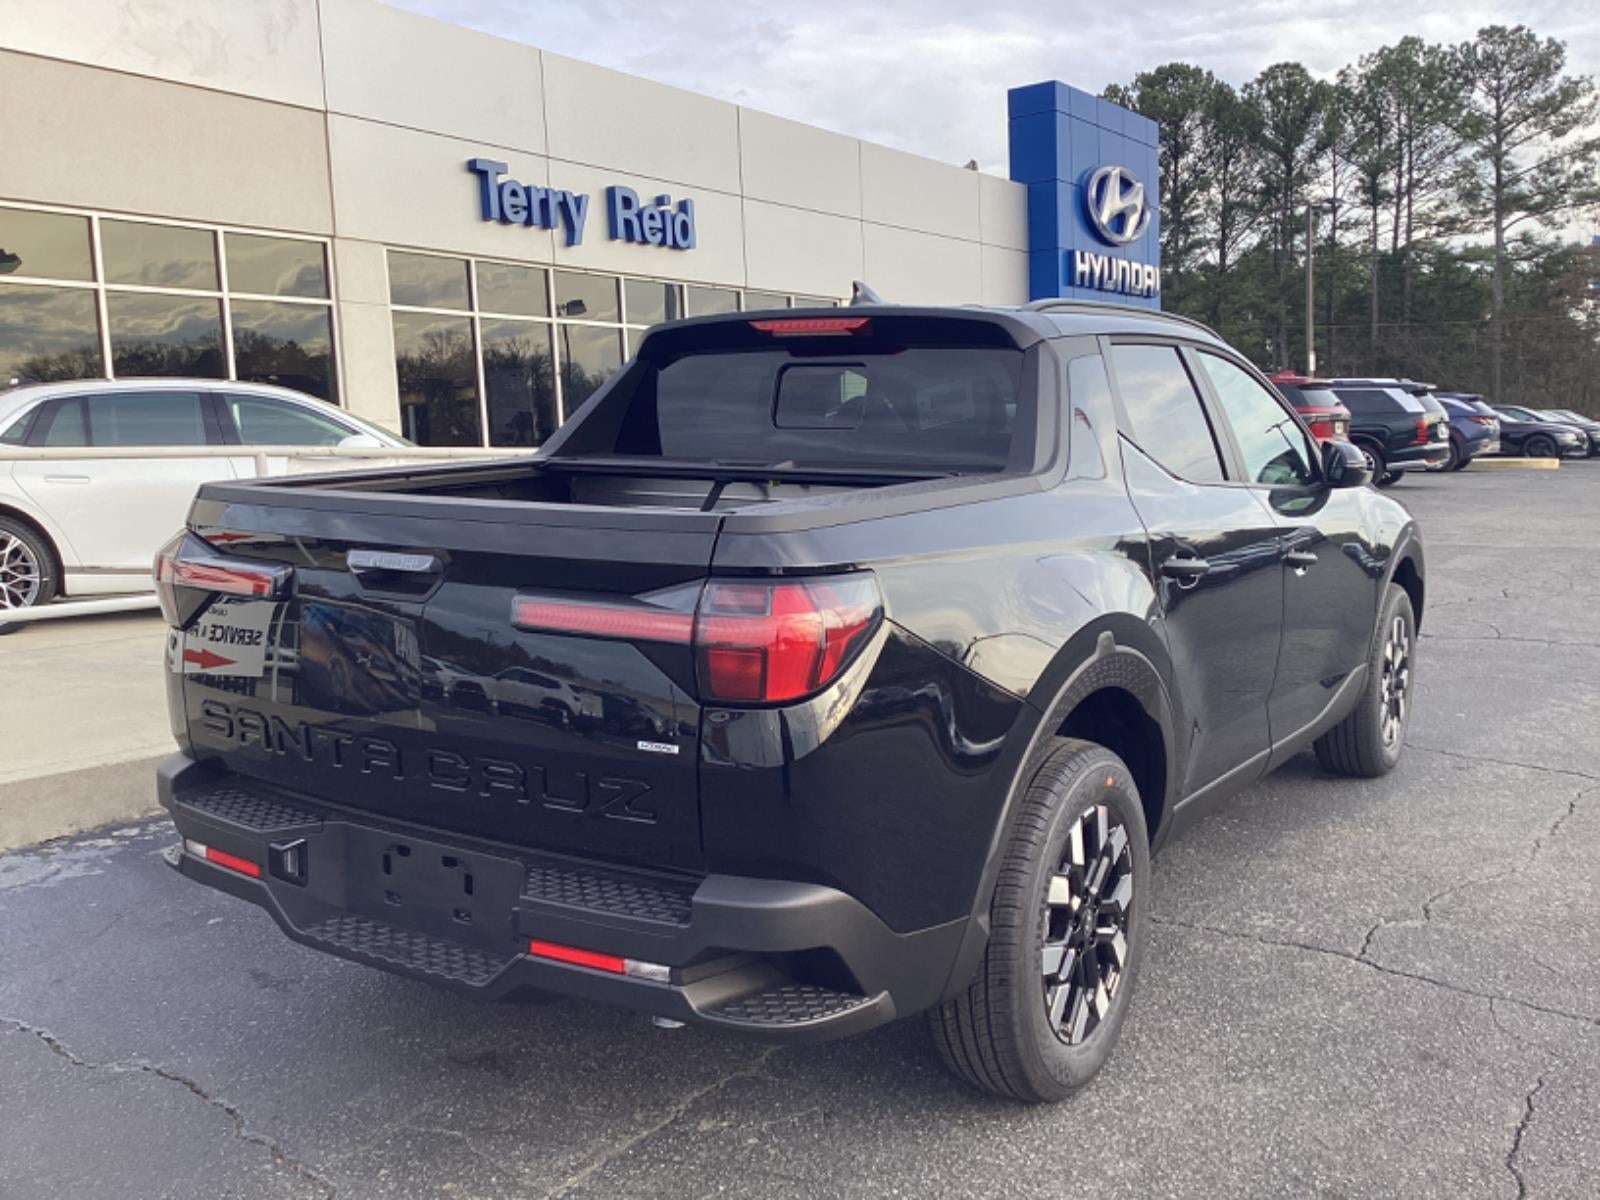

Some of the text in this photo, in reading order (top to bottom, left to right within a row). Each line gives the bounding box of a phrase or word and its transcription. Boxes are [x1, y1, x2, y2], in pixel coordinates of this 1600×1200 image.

[466, 158, 696, 250] Terry Reid
[1074, 250, 1161, 297] HYUNDAI
[200, 698, 657, 825] SANTA CRUZ
